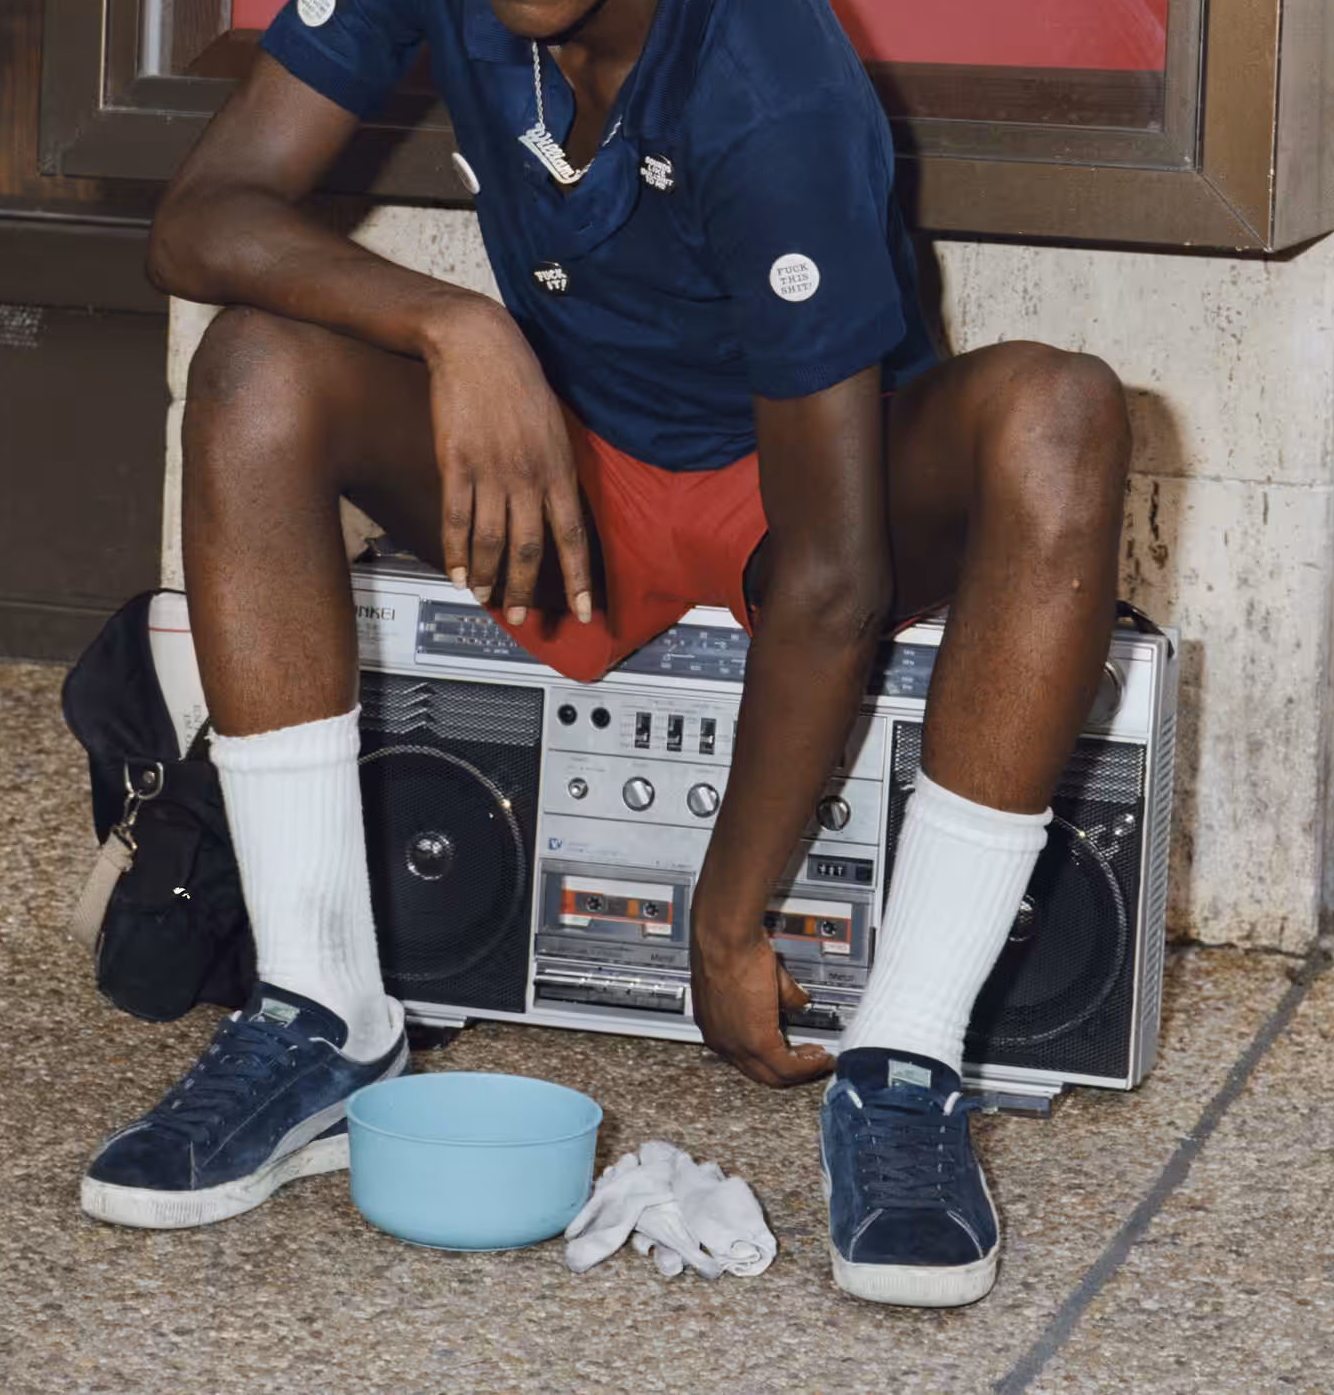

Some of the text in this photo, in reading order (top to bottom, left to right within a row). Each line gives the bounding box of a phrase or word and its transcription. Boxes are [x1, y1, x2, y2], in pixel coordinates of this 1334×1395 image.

[776, 263, 809, 276] FUCK
[779, 274, 809, 286] THIS
[354, 605, 396, 622] NKEI
